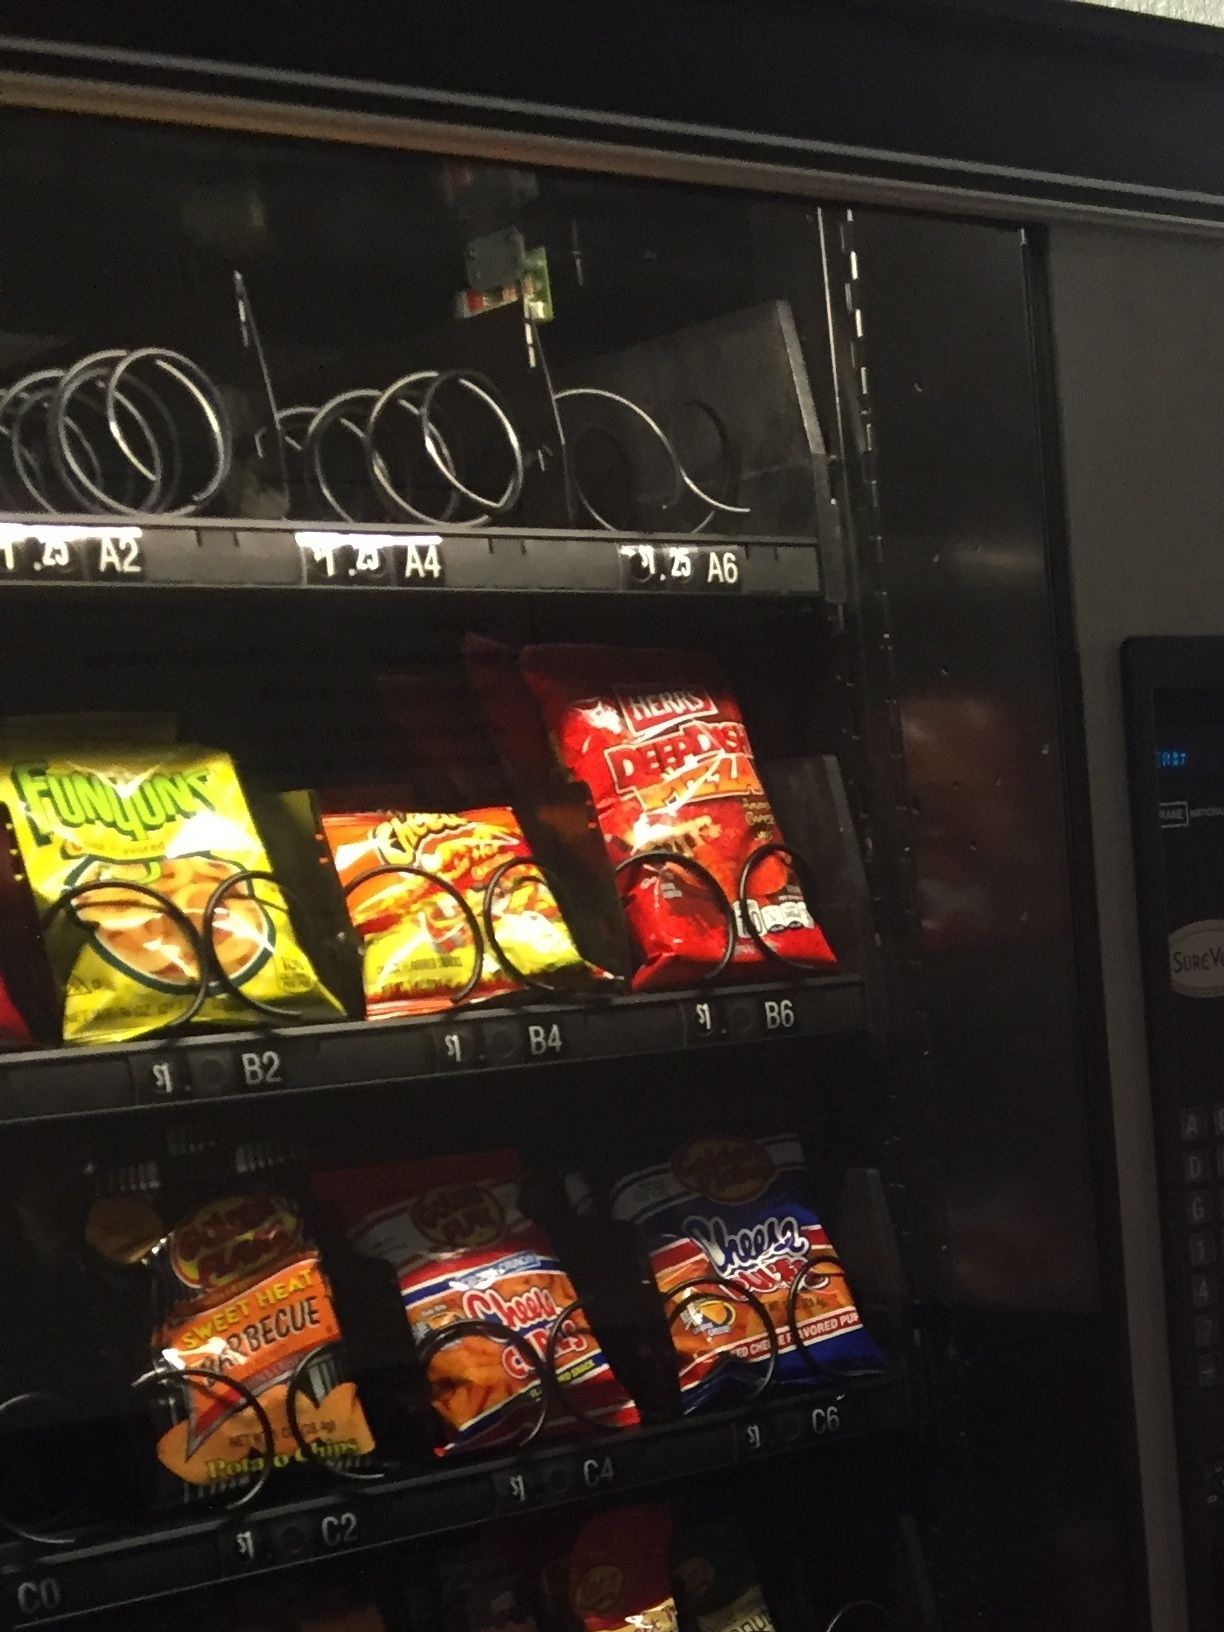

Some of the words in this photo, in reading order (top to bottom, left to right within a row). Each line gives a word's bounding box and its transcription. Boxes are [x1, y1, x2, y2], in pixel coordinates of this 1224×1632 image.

[99, 536, 141, 573] A2
[404, 543, 441, 578] A4
[706, 551, 739, 583] A6
[12, 760, 216, 847] FUNYUNS
[696, 1002, 713, 1029] $1
[764, 1000, 796, 1029] B6
[445, 1033, 463, 1062] $1
[528, 1023, 564, 1055] B4
[152, 1061, 173, 1093] $1
[241, 1050, 283, 1085] B2
[181, 1299, 249, 1349] SWEET
[255, 1268, 314, 1309] HEAT
[811, 1406, 842, 1435] C6
[583, 1456, 614, 1487] C4
[236, 1530, 256, 1560] $1
[320, 1511, 358, 1547] C2
